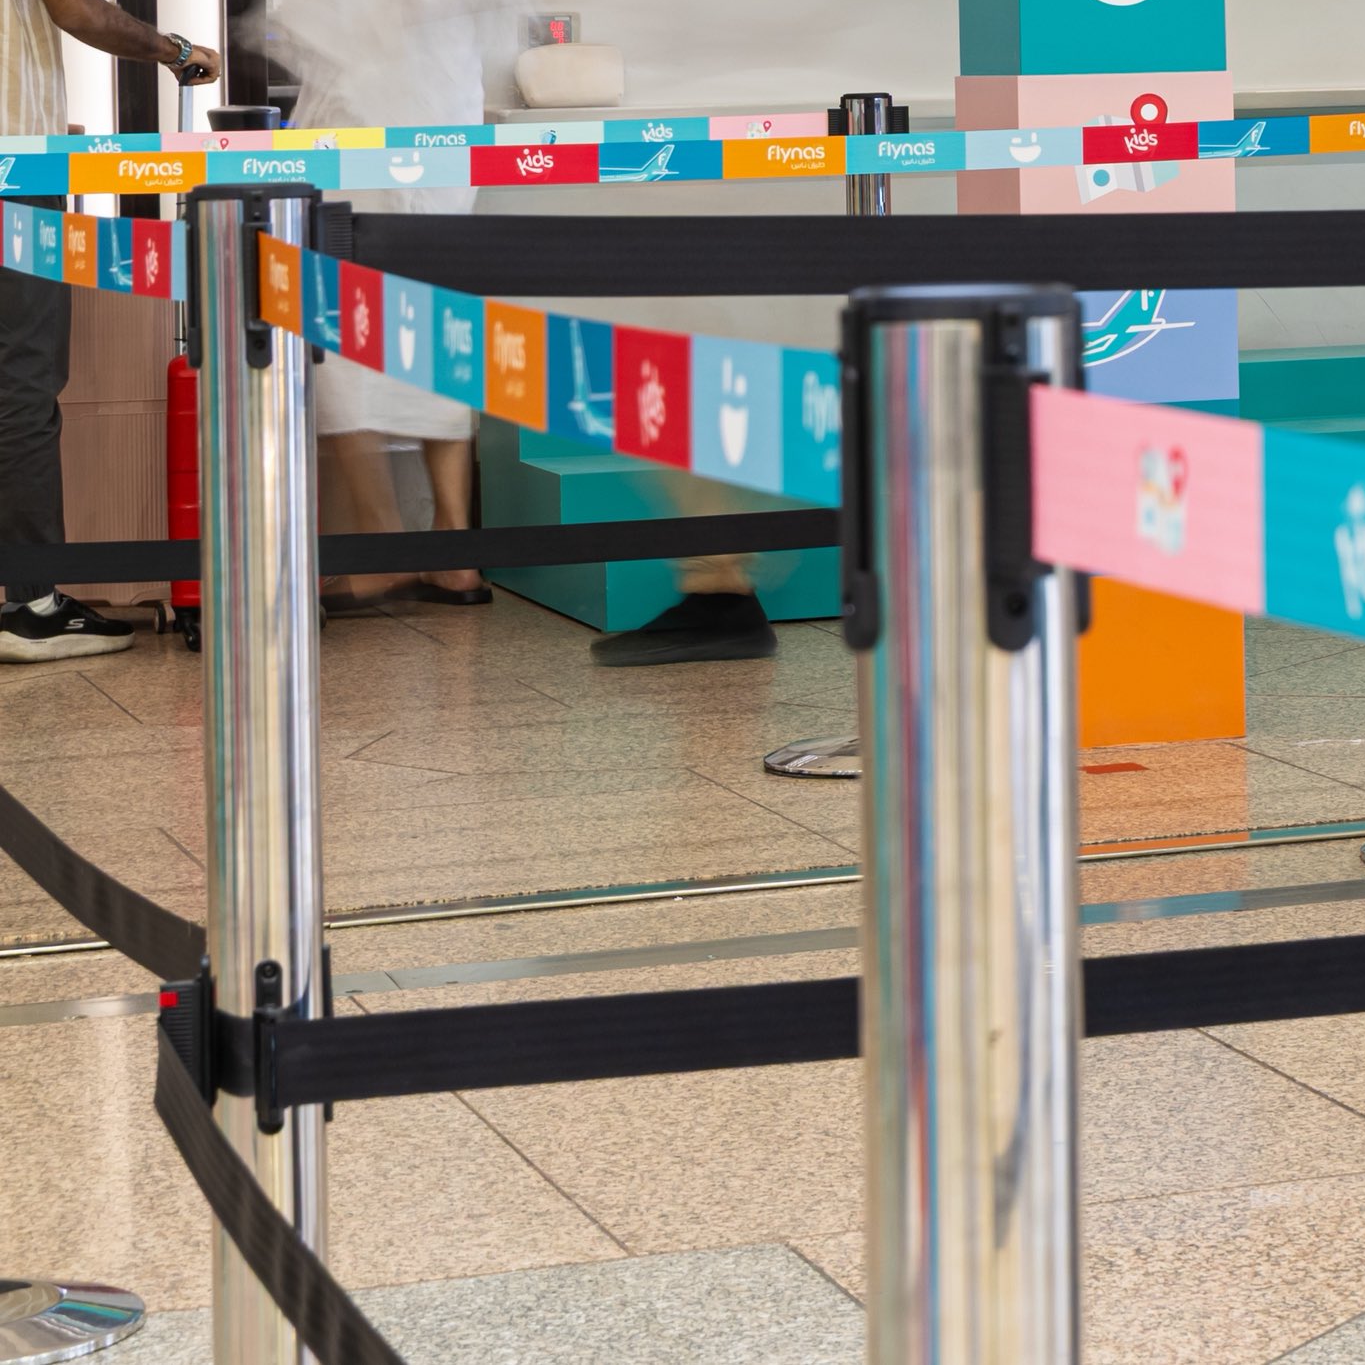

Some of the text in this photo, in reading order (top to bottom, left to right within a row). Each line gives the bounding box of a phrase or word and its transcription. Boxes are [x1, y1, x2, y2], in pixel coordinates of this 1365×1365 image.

[414, 133, 466, 147] flynas
[1124, 127, 1158, 154] kids
[767, 145, 825, 163] flynas
[878, 141, 935, 160] flynas
[118, 160, 183, 180] flynas
[242, 158, 306, 178] flynas
[516, 148, 554, 176] kids
